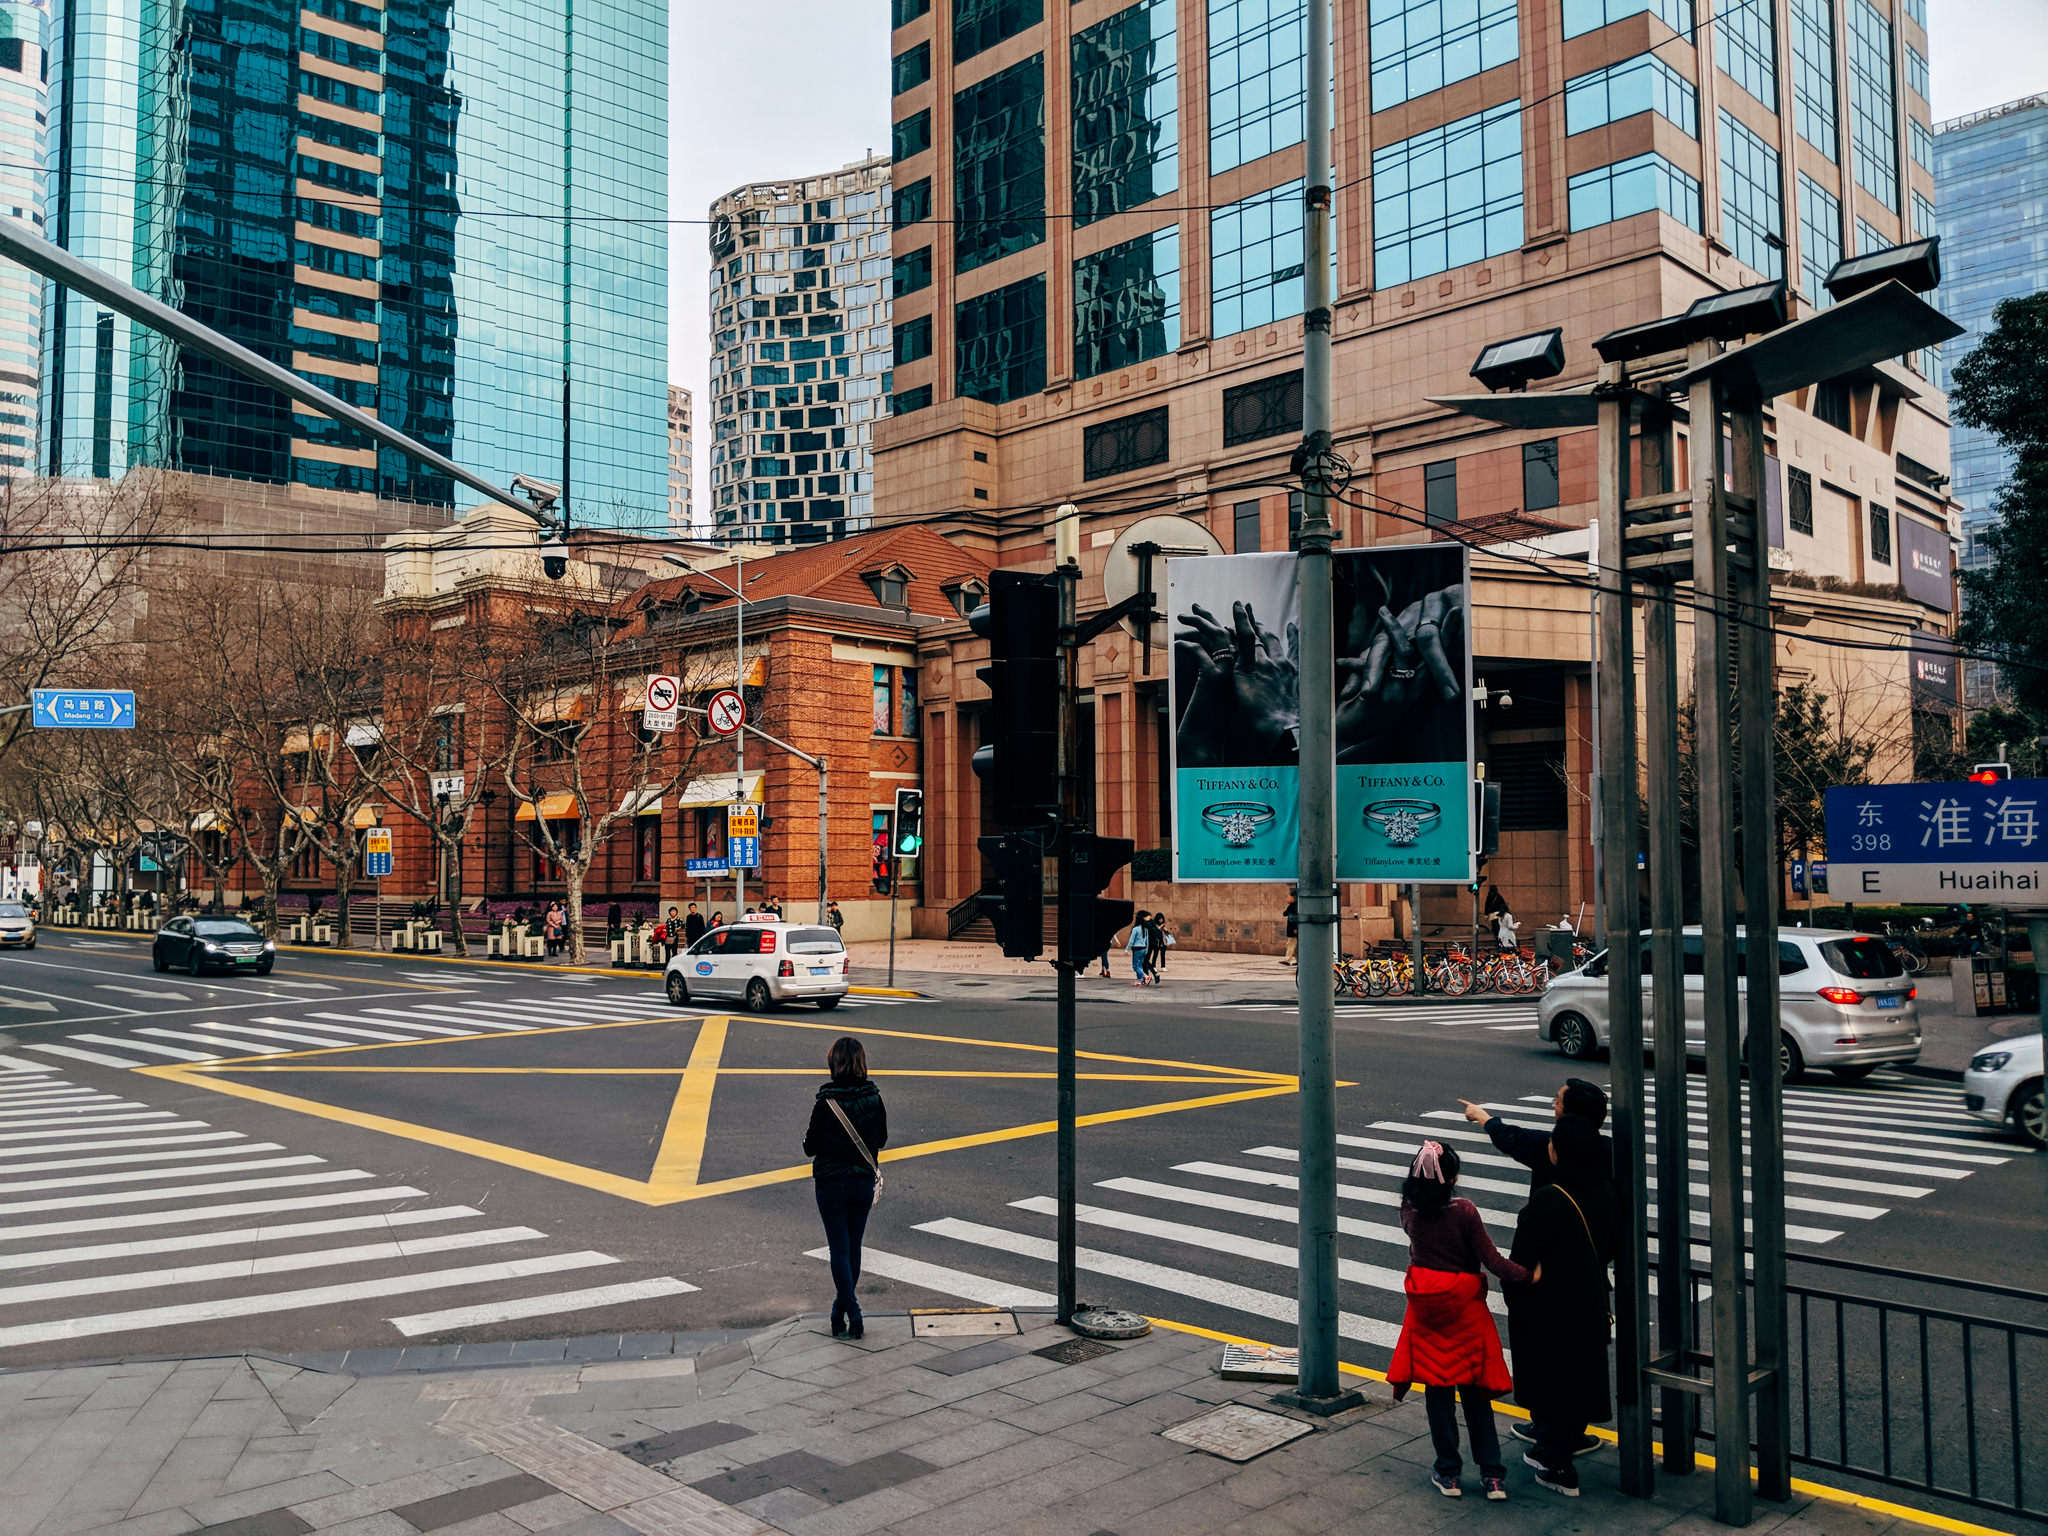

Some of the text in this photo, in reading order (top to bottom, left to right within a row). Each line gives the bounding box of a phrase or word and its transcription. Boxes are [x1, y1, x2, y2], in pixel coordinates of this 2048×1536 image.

[64, 699, 105, 710] 马当路
[64, 712, 91, 720] Madang
[1856, 801, 1884, 827] 东
[1918, 795, 2040, 848] 淮海
[1851, 833, 1891, 851] 398
[1203, 858, 1242, 868] TiffanyLove
[1364, 857, 1405, 868] TiffanyLove
[1793, 864, 1803, 880] P
[1940, 870, 2039, 890] Huaihai
[1862, 870, 1881, 893] E
